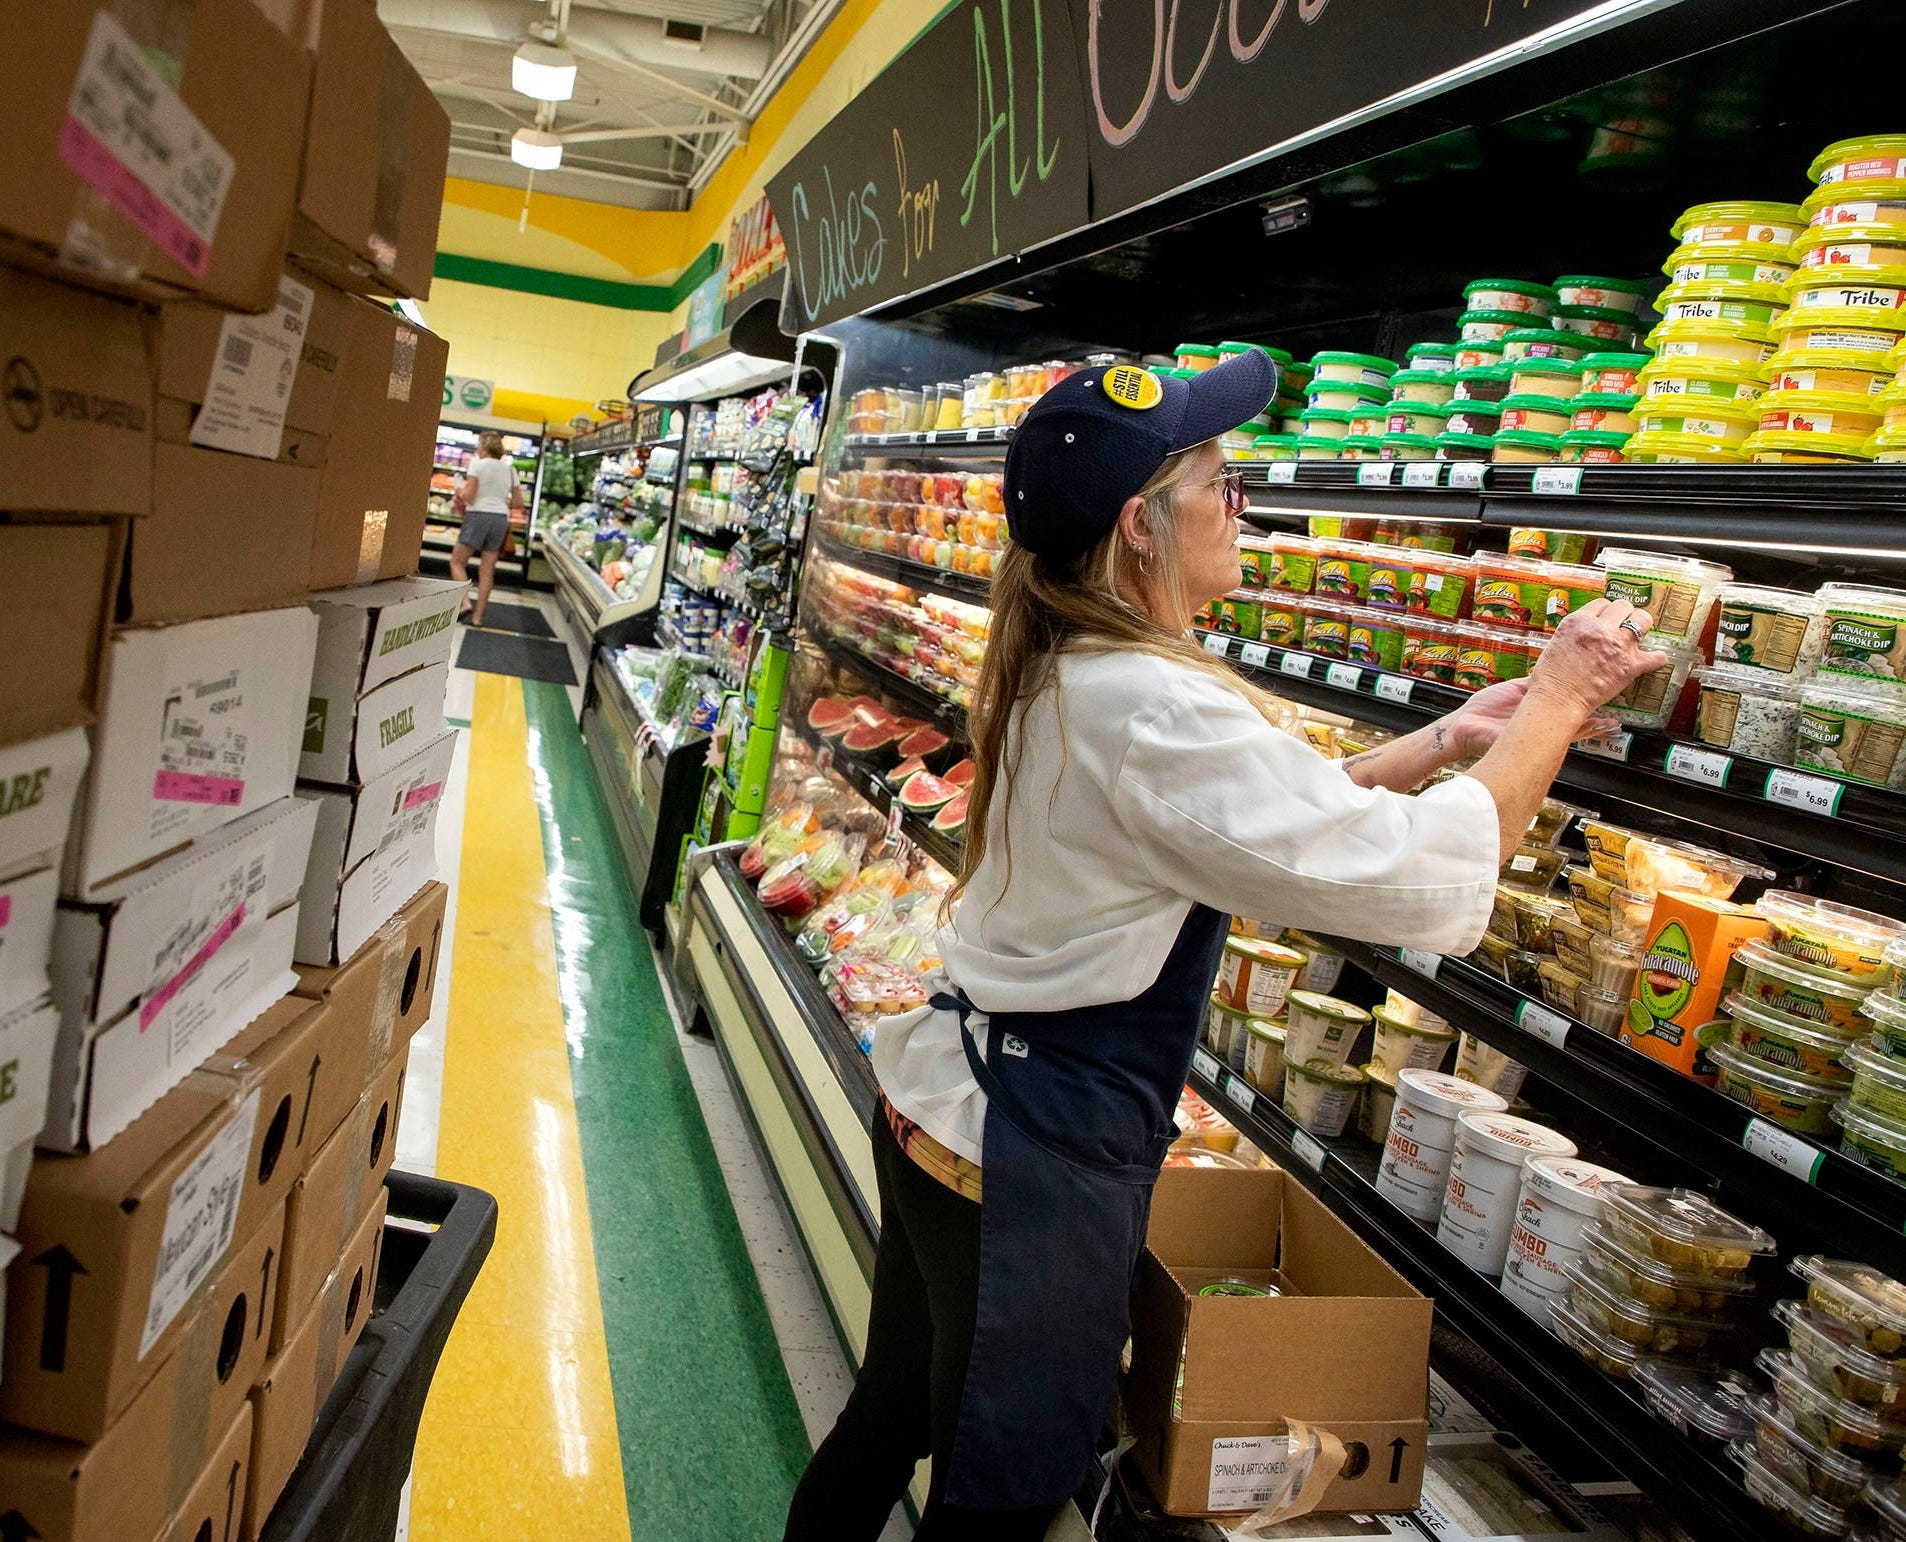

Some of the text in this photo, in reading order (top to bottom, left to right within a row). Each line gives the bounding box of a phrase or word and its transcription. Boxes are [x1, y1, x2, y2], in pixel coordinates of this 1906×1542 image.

[793, 165, 887, 323] Cakes
[1840, 289, 1890, 306] Tribe
[1678, 303, 1713, 318] Tribe
[1112, 369, 1129, 397] #STILL
[1652, 380, 1681, 394] Tribe
[1481, 584, 1516, 599] Salsa
[1635, 596, 1648, 604] DIP
[1735, 623, 1750, 632] DIP
[1837, 624, 1871, 639] SPINACH
[380, 621, 417, 656] HANDLE
[1831, 633, 1891, 648] ARTICHOKE DIP
[1419, 645, 1461, 661] Salsa
[1461, 652, 1490, 667] Salsa
[379, 705, 415, 750] FRAGILE
[1824, 734, 1840, 742] DIP
[1606, 741, 1623, 754] $6.99
[1700, 764, 1720, 779] $6.99
[1805, 791, 1828, 807] $6.99
[1655, 945, 1688, 959] YUCATAN
[1778, 939, 1838, 968] Guacamole
[1640, 951, 1700, 986] Guacamole
[1768, 992, 1832, 1021] Guacamole
[1746, 1041, 1807, 1071] Guacamole
[1386, 1129, 1420, 1159] UMBO
[1415, 1164, 1441, 1176] SHRIMP
[1462, 1205, 1487, 1220] SHRIMP
[1513, 1223, 1547, 1257] UMBO
[1214, 1442, 1234, 1450] Chuck
[1214, 1463, 1240, 1477] SPINACH
[1241, 1464, 1246, 1476] &
[1247, 1461, 1279, 1475] ARTICHOKE
[1416, 1506, 1447, 1532] AKE
